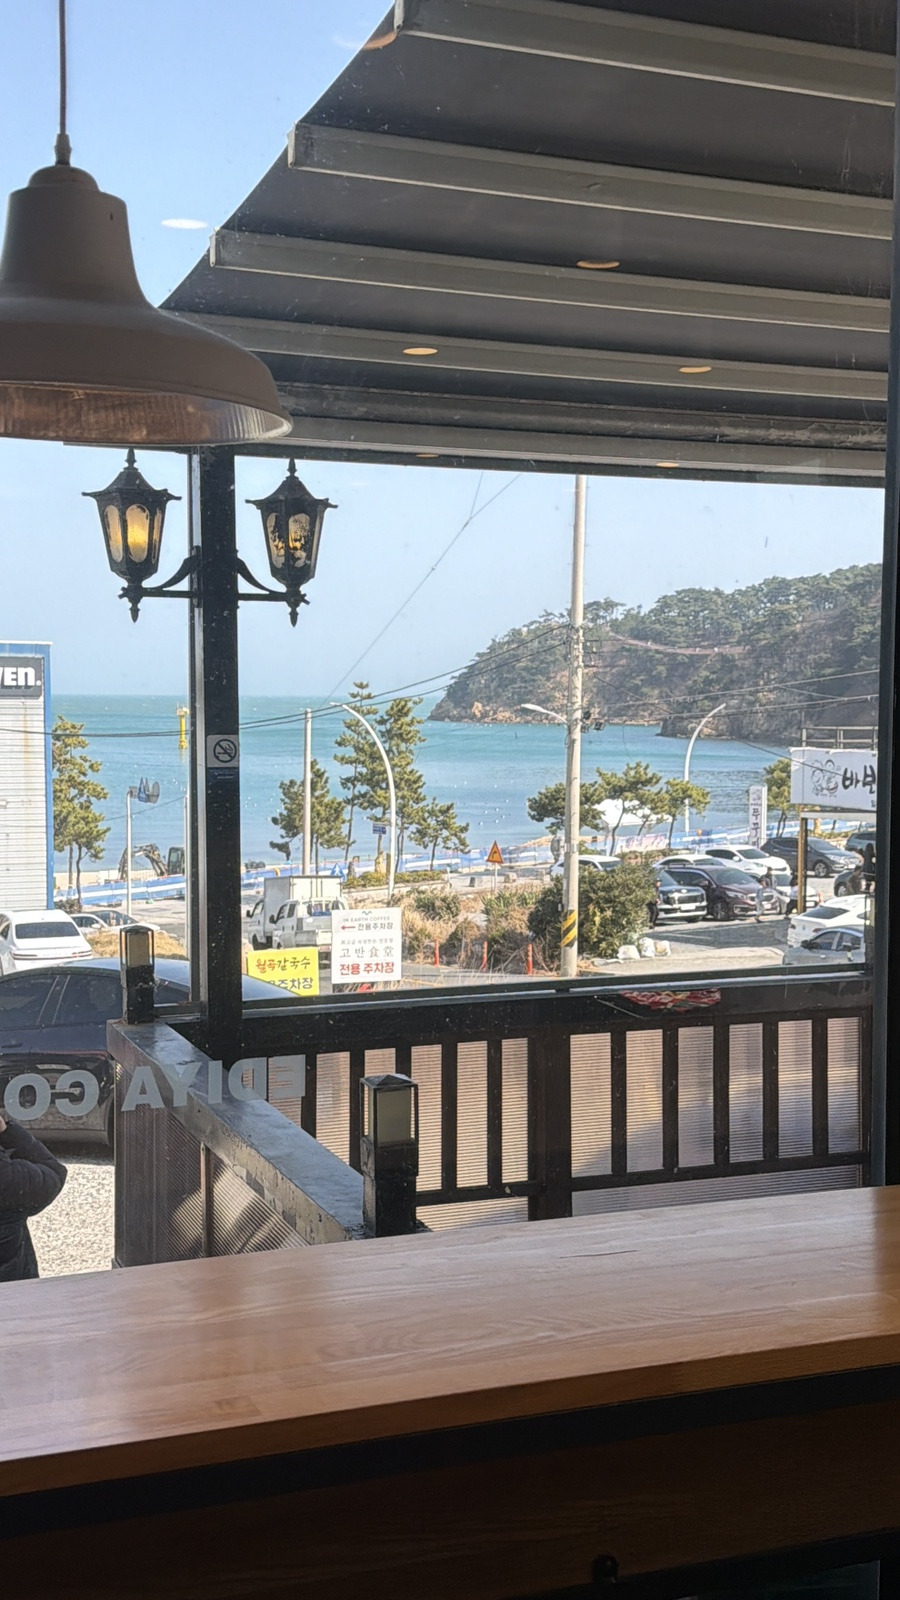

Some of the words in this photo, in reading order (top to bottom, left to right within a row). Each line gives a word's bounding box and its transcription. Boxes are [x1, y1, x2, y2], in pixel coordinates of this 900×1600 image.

[358, 922, 393, 931] 전용주차장
[340, 963, 360, 975] 전용
[363, 962, 394, 974] 주차장
[268, 977, 313, 990] 주차장
